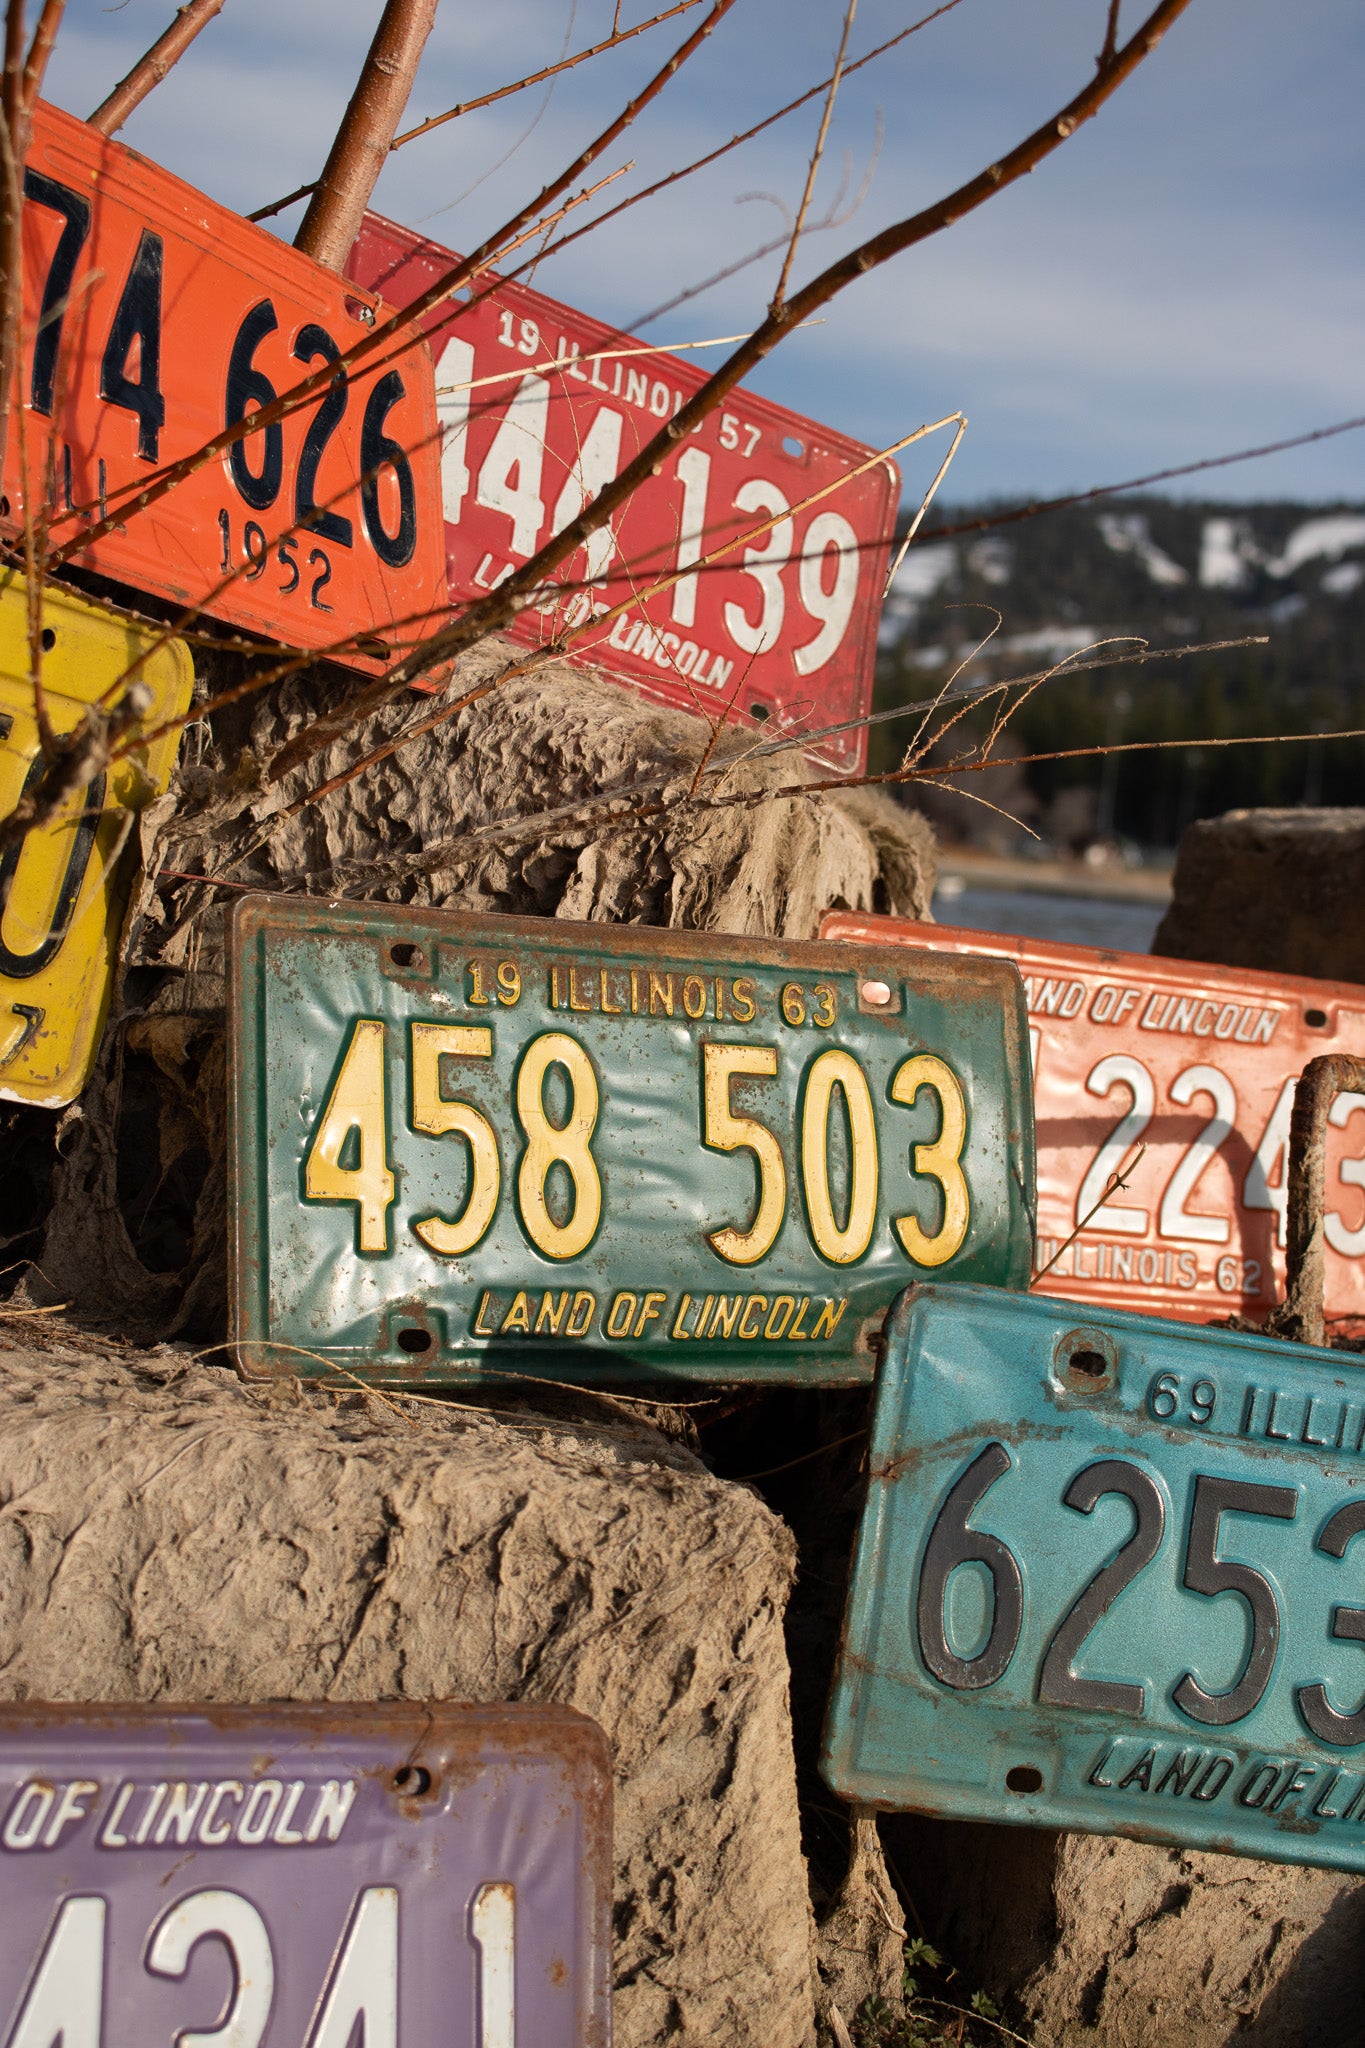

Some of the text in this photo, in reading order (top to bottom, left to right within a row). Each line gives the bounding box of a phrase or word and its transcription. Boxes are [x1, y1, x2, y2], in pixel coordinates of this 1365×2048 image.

[498, 310, 540, 357] 19
[718, 413, 762, 458] 57
[226, 298, 417, 568] 626
[218, 508, 334, 613] 1952
[672, 447, 860, 676] 139
[609, 612, 734, 690] LINCOLN
[467, 959, 836, 1028] 19 ILLINOIS 63
[1091, 984, 1141, 1024] OF
[1141, 994, 1280, 1044] LINCOLN
[304, 1019, 971, 1268] 458 503
[1035, 1238, 1262, 1295] ILLINOIS 62
[474, 1290, 849, 1340] LAND OF LINCOLN
[1151, 1371, 1217, 1425] 69
[1088, 1746, 1235, 1801] LAND
[1239, 1762, 1316, 1810] OF
[3, 1780, 358, 1849] OF LINCOLN
